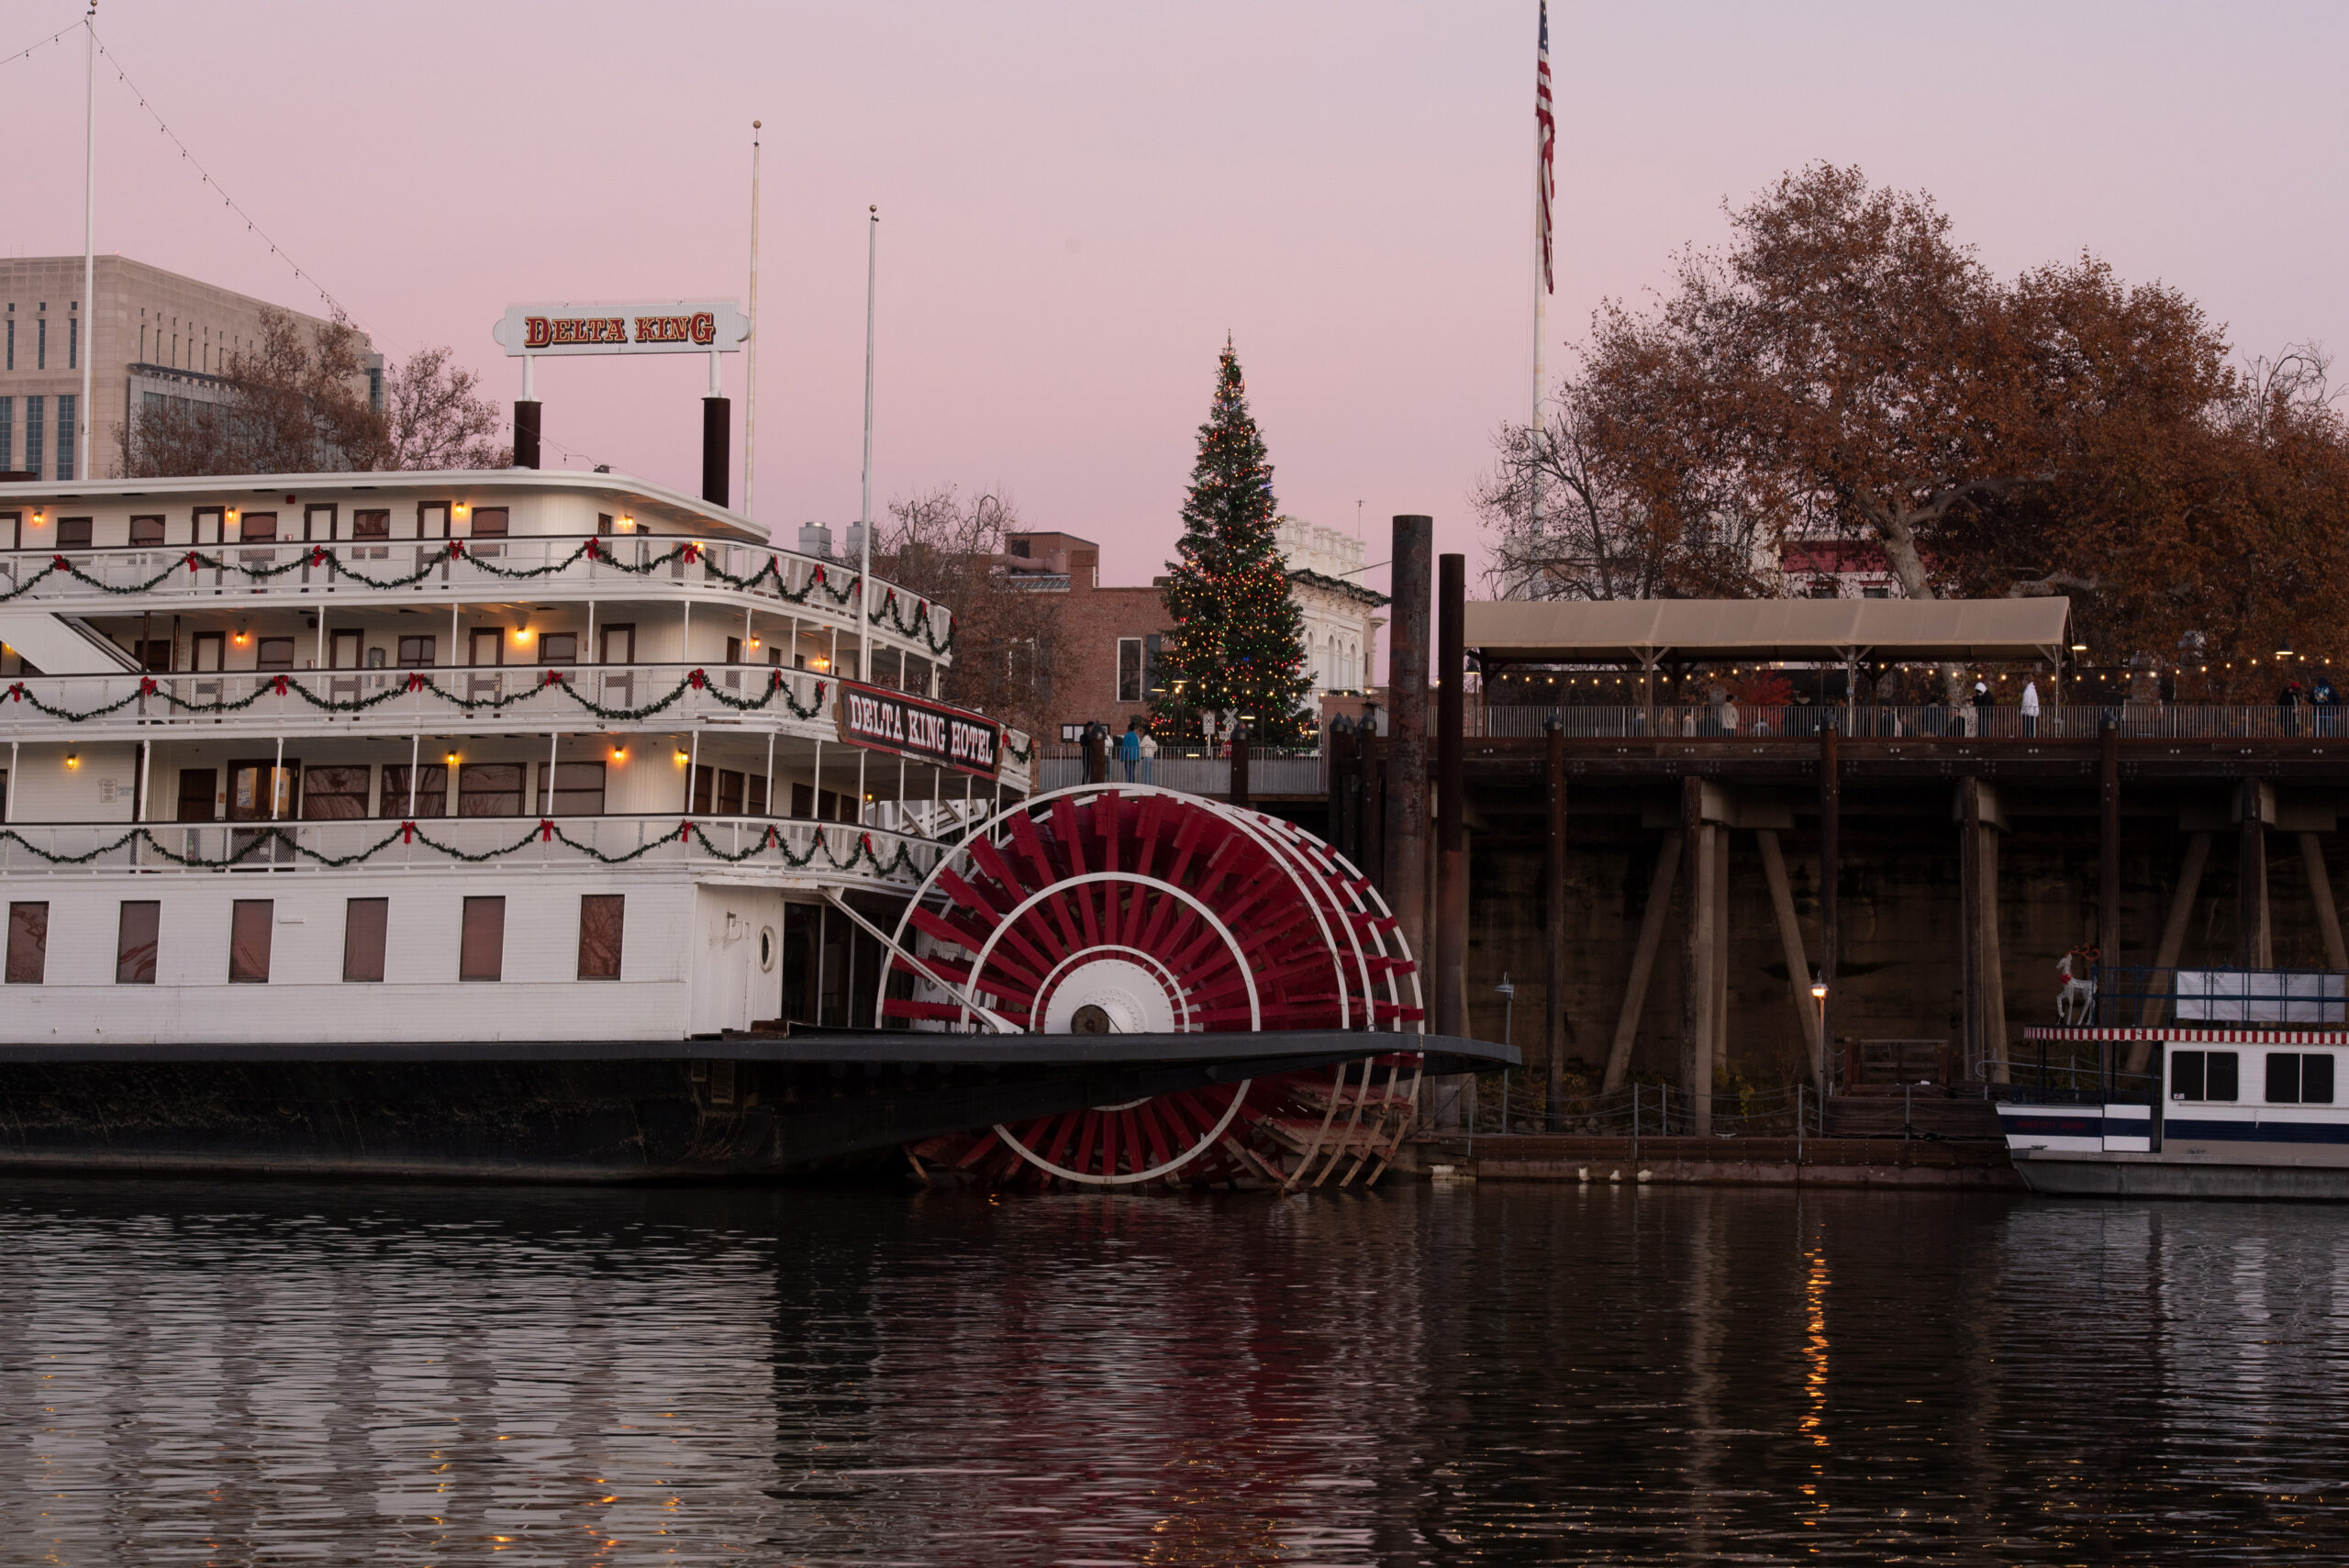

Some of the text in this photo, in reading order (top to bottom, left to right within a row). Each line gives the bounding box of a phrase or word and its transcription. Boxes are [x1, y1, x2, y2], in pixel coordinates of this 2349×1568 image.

[524, 312, 717, 348] DELTA KING
[849, 694, 994, 766] DELTA KING HOTEL
